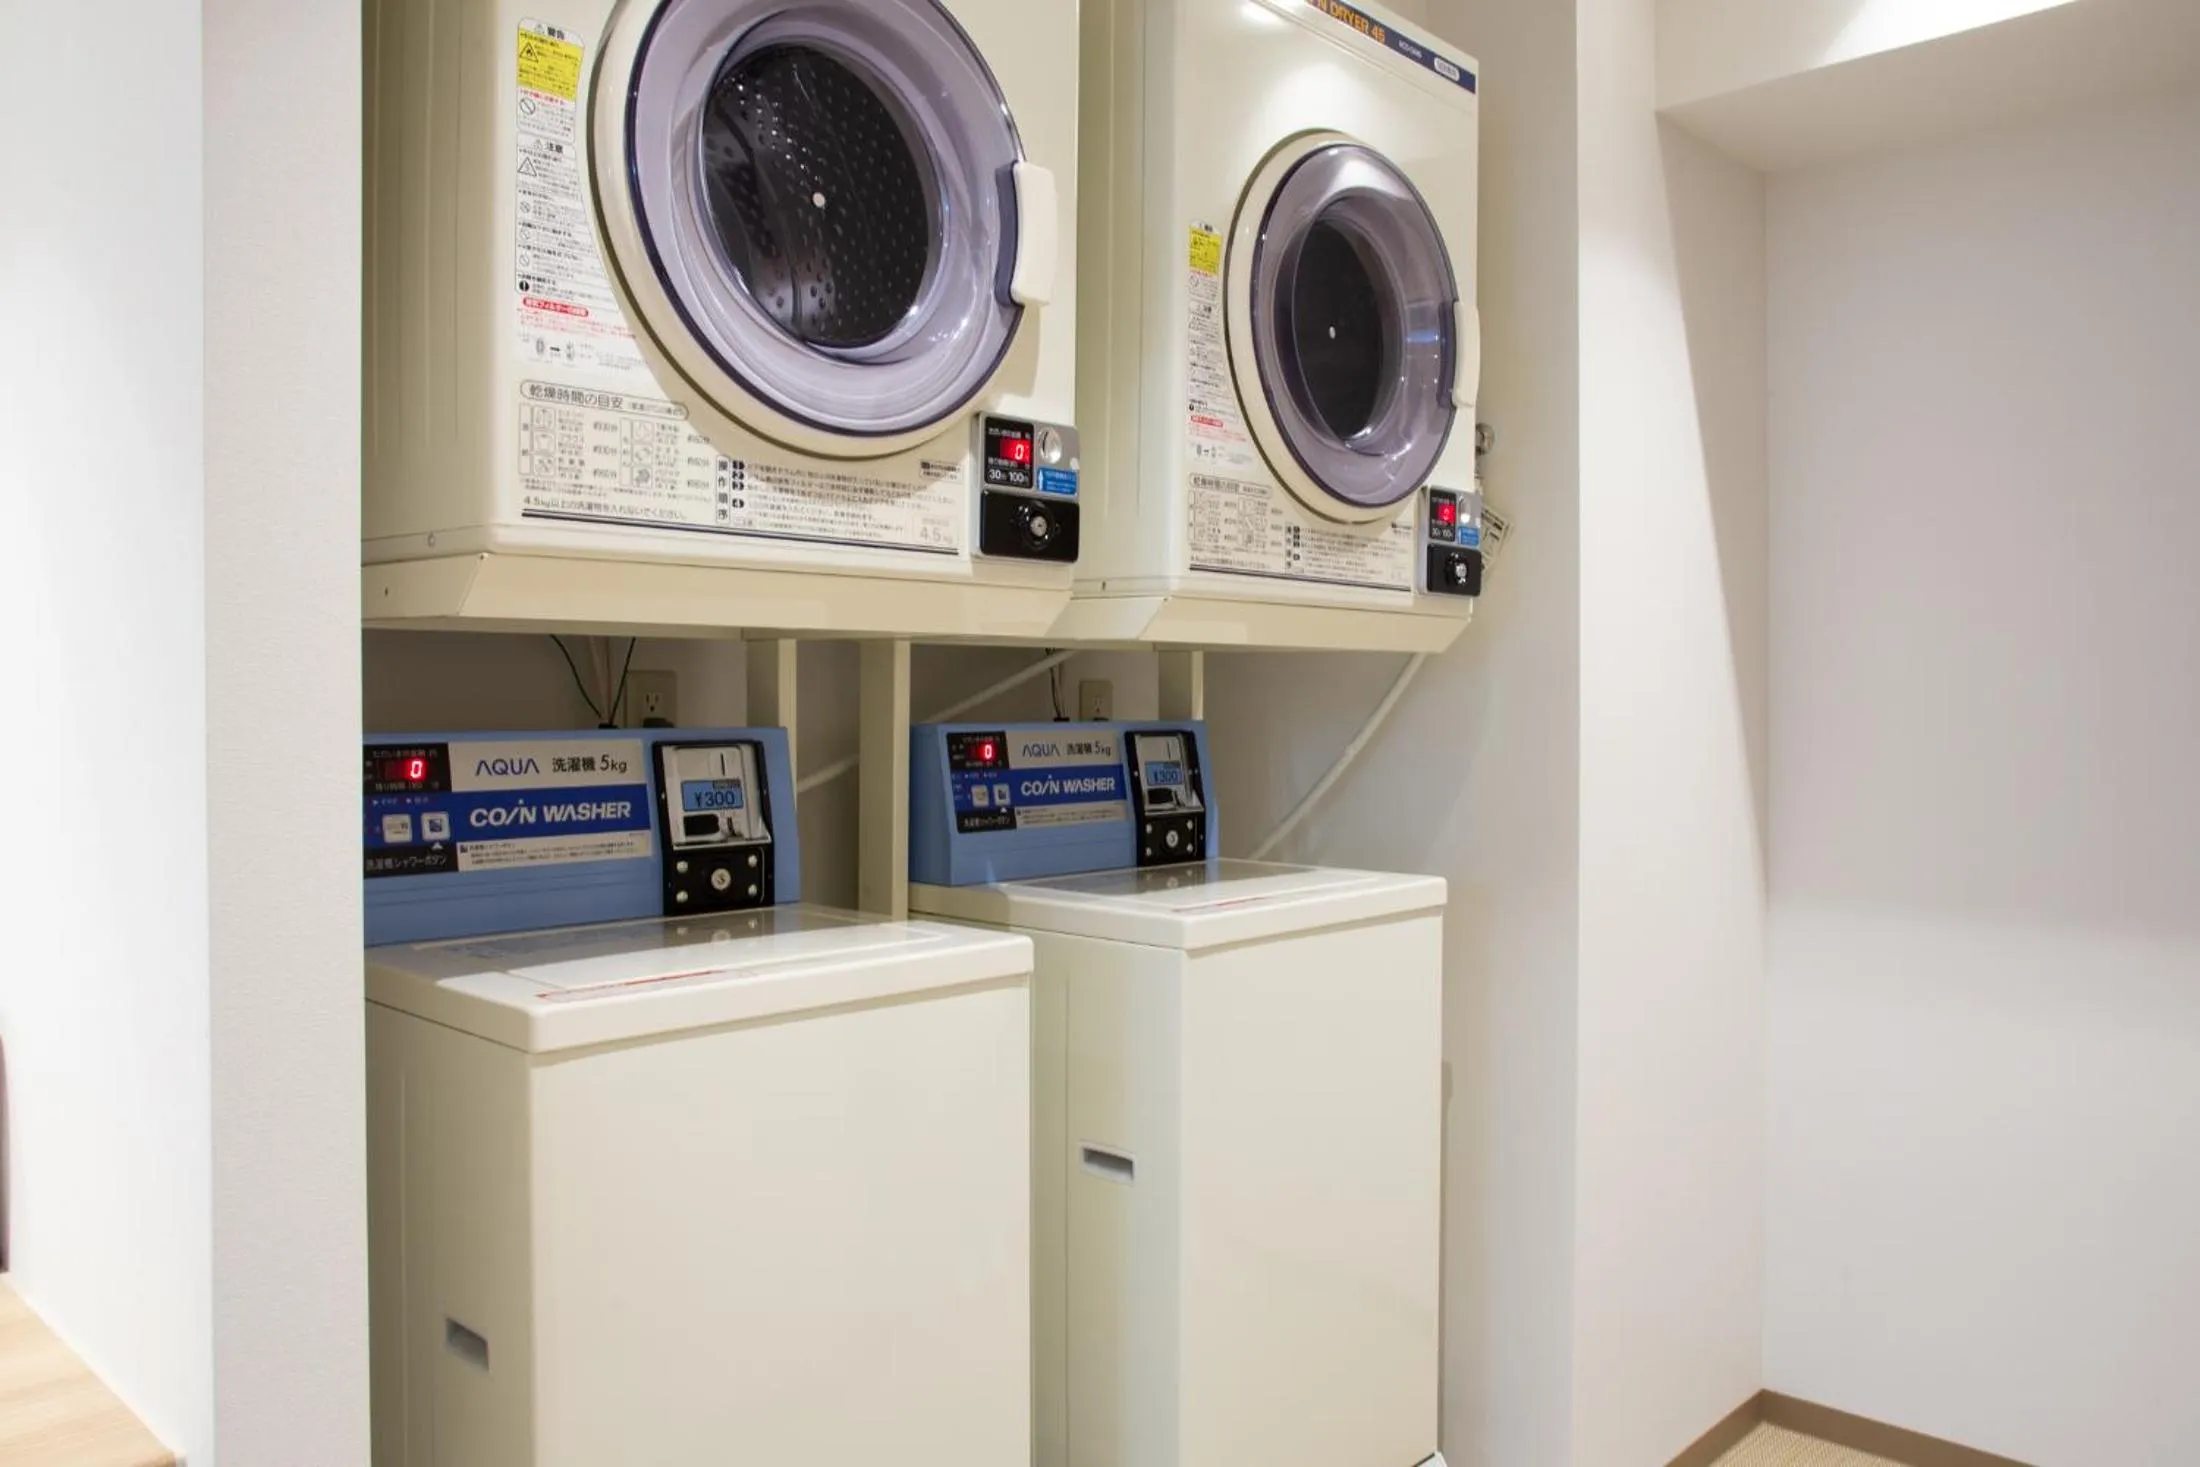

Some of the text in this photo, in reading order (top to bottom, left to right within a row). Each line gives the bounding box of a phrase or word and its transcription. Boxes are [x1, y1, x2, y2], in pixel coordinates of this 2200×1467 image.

[1330, 1, 1370, 34] DRYER
[1371, 24, 1385, 45] 45
[529, 384, 624, 410] 乾燥時間の目安
[1014, 443, 1025, 460] 0
[984, 744, 993, 760] 0
[1022, 743, 1060, 758] AQUA
[410, 760, 423, 778] 0
[475, 754, 628, 776] AQUA 洗濯機 5kg
[1020, 774, 1116, 797] COIN WASHER
[694, 790, 736, 808] ¥300
[470, 798, 632, 827] COIN WASHER
